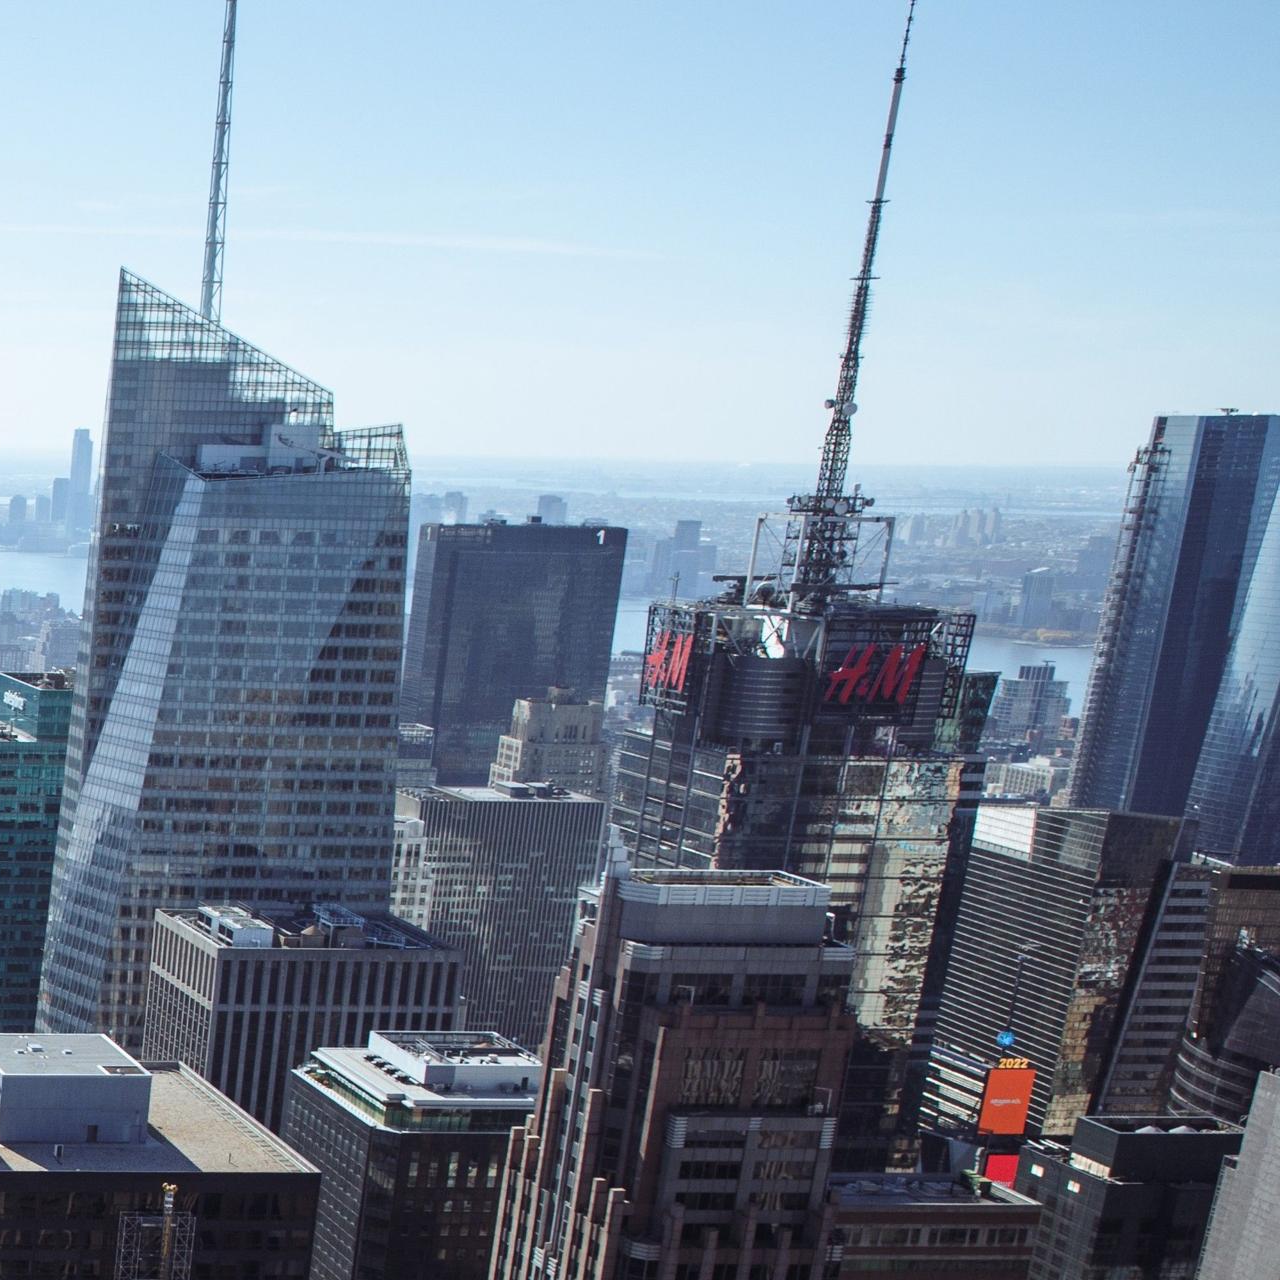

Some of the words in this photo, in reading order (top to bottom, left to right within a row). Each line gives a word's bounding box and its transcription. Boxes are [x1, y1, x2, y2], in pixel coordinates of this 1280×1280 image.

[596, 529, 606, 545] 1
[642, 629, 694, 694] H&M
[824, 642, 928, 704] H&M
[998, 1057, 1028, 1068] 2022
